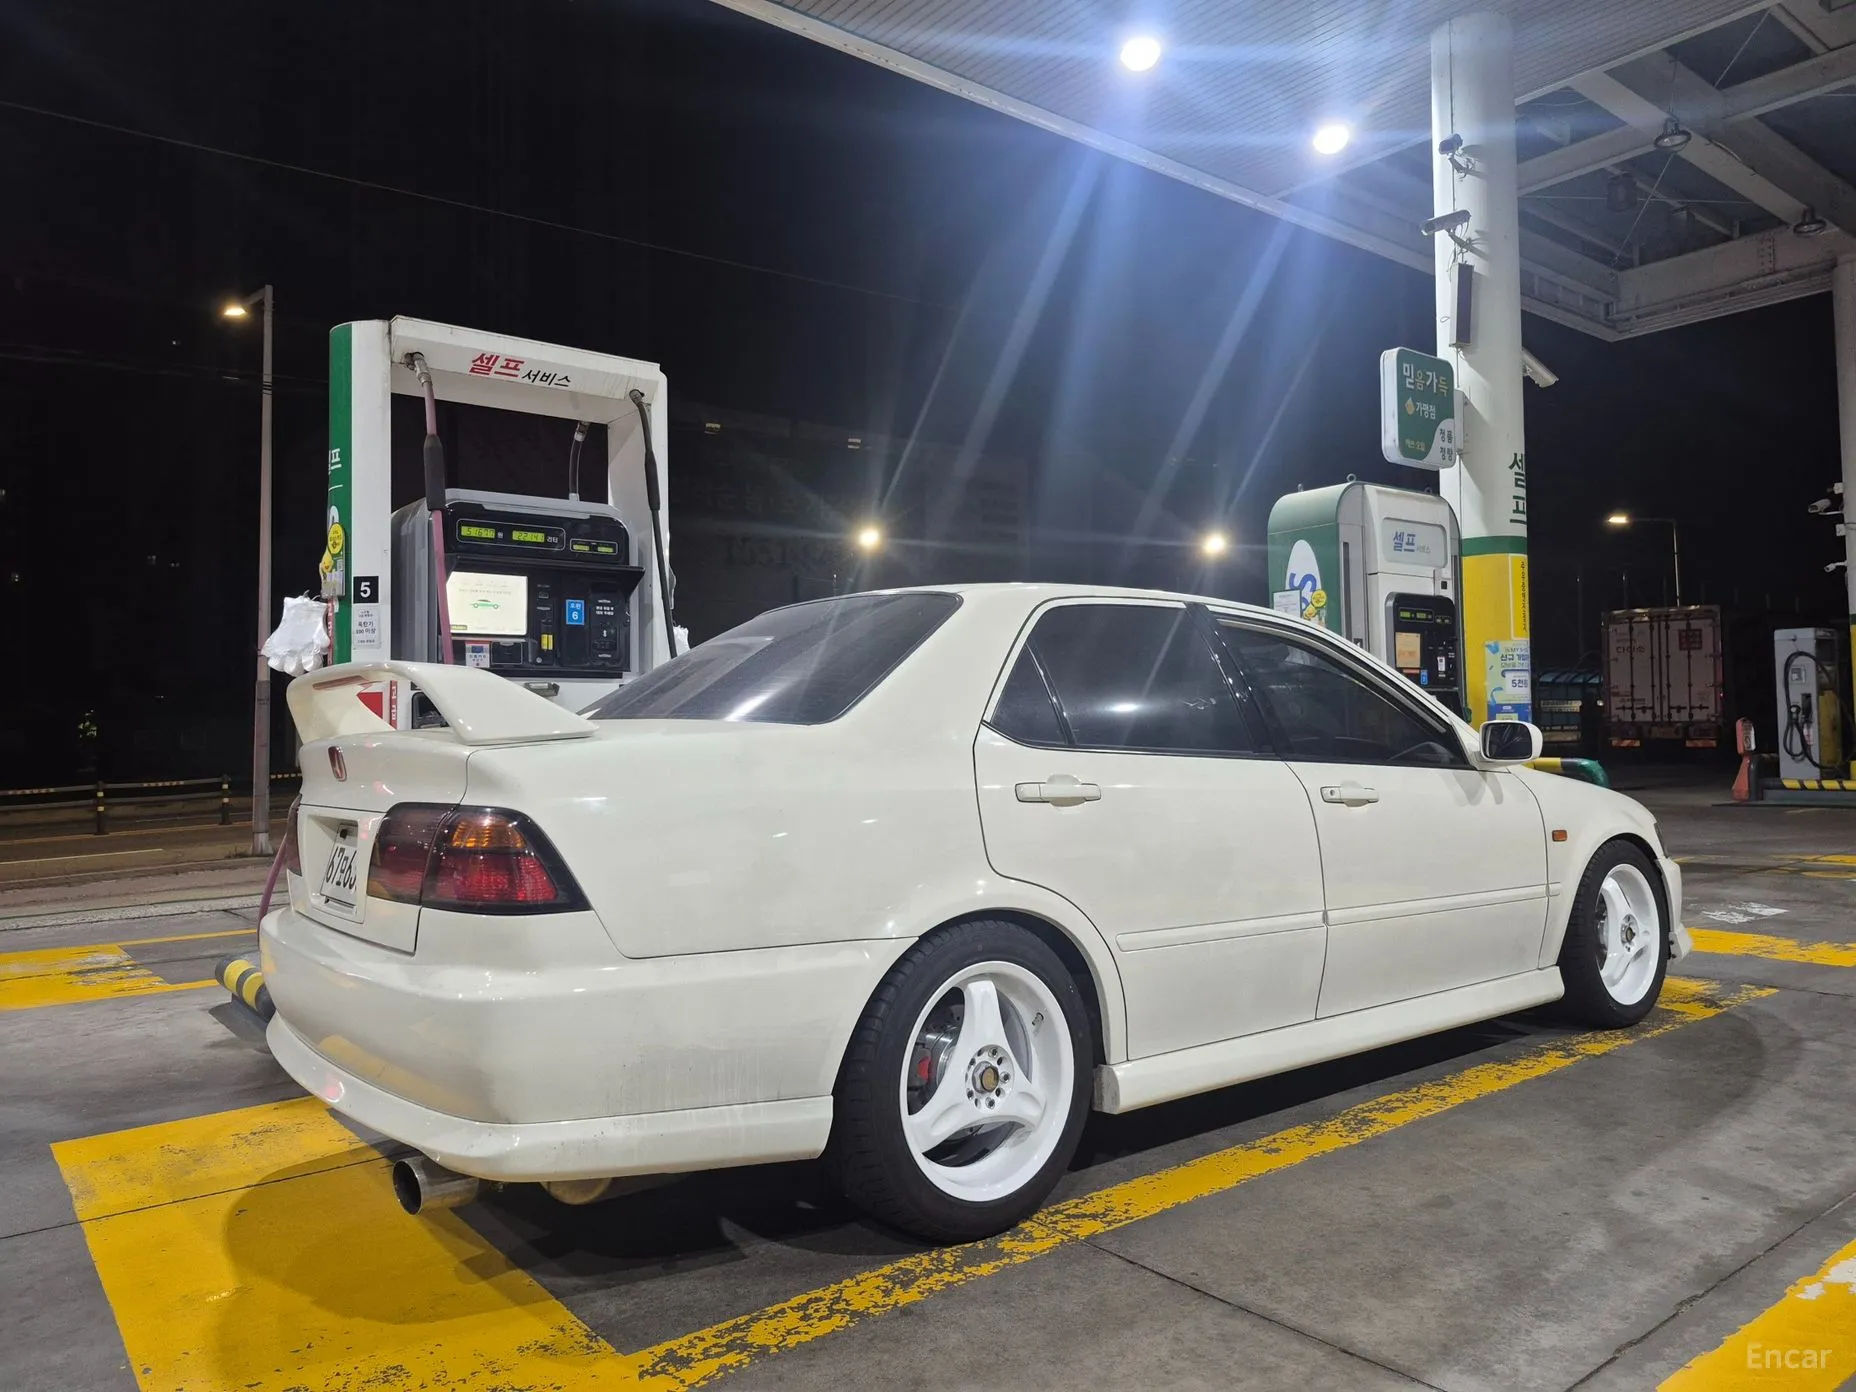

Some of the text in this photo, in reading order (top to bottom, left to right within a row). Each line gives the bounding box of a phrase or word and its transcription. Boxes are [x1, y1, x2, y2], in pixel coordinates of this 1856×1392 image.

[469, 353, 571, 387] 셀프 서비스
[1403, 362, 1449, 397] 믿음가득
[1415, 401, 1436, 420] 가맹점
[1393, 530, 1416, 552] 셀프
[360, 582, 371, 598] 5
[571, 611, 579, 620] 6
